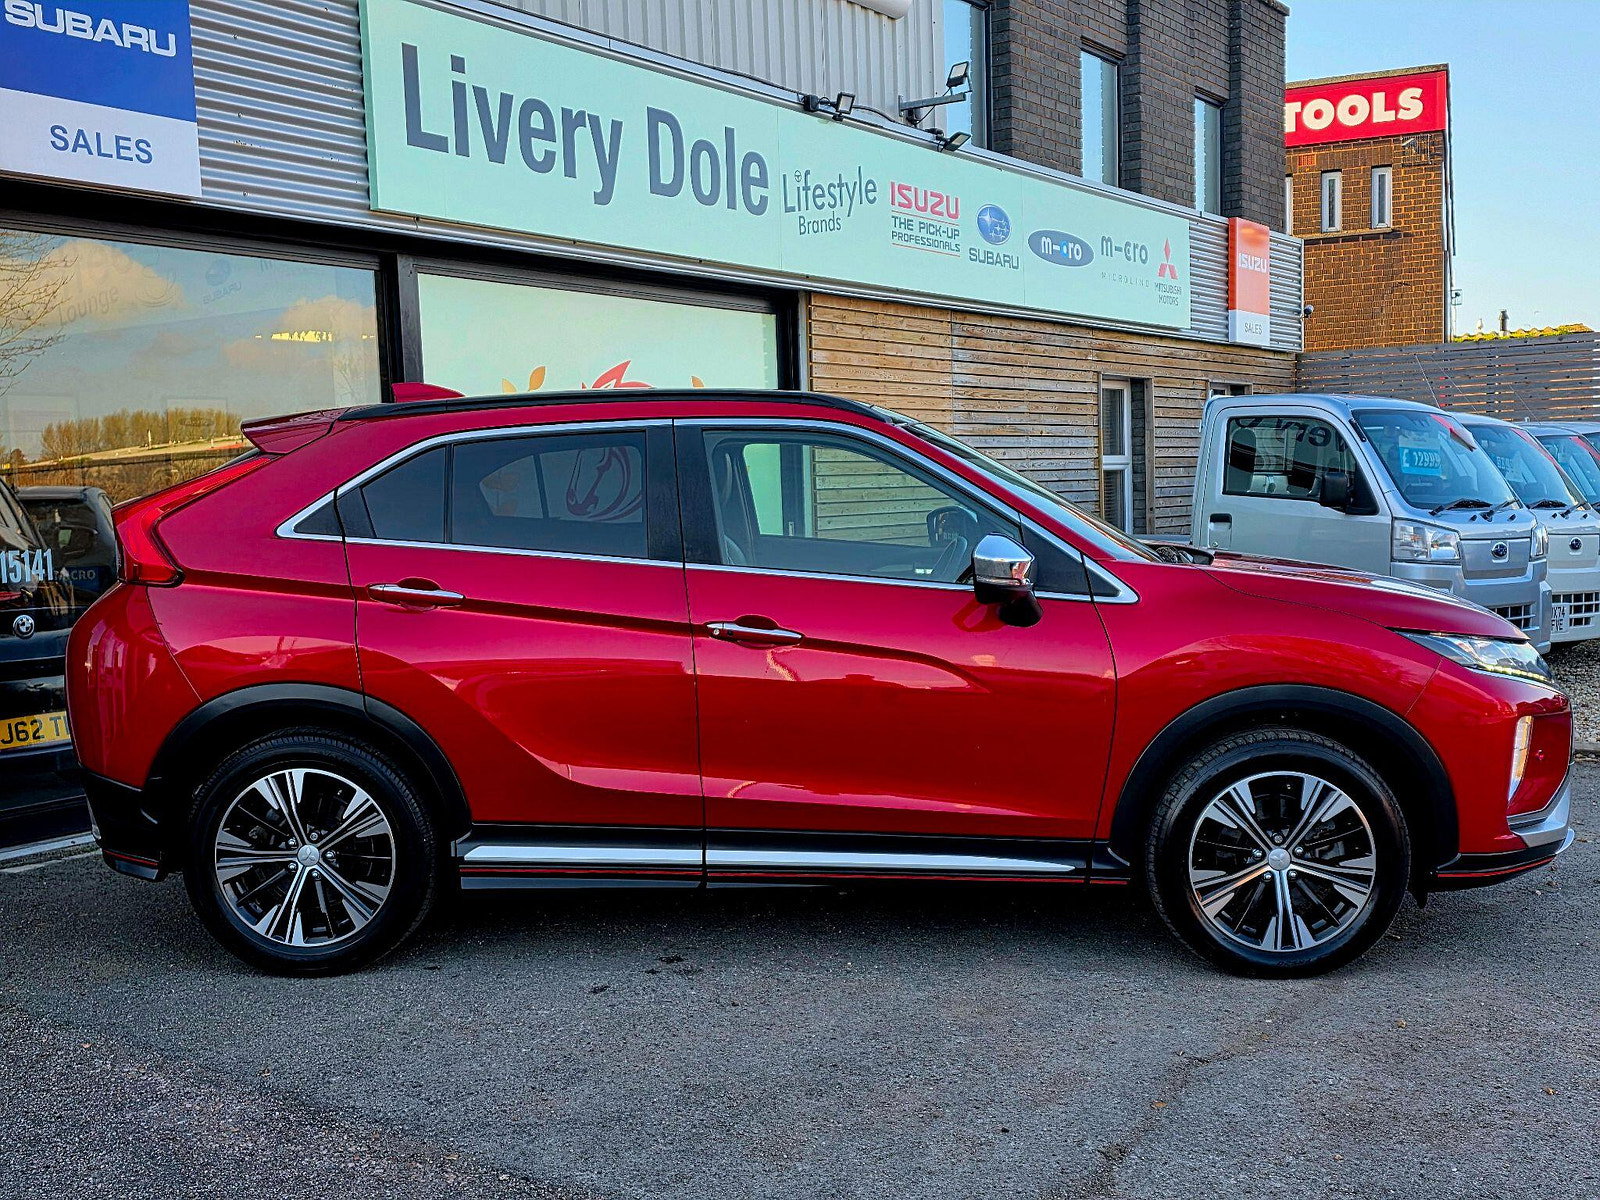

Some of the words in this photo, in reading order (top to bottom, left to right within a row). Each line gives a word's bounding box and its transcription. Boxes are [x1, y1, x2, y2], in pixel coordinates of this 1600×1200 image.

[4, 0, 177, 57] SUBARU
[1284, 87, 1423, 133] TOOLS
[401, 42, 623, 206] Livery
[647, 106, 769, 216] Dole
[50, 124, 153, 164] SALES
[782, 166, 878, 218] Lifestyle
[890, 181, 960, 220] ISUZU
[798, 211, 842, 235] Brands
[891, 215, 914, 231] THE
[918, 222, 960, 240] PICK-UP
[891, 231, 961, 253] PROFESSIONALS
[969, 247, 1020, 270] SUBARU
[1239, 253, 1267, 273] ISUZU
[1154, 282, 1182, 296] MITSUBISHI
[1158, 295, 1179, 306] MOTORS
[1244, 322, 1263, 335] SALES
